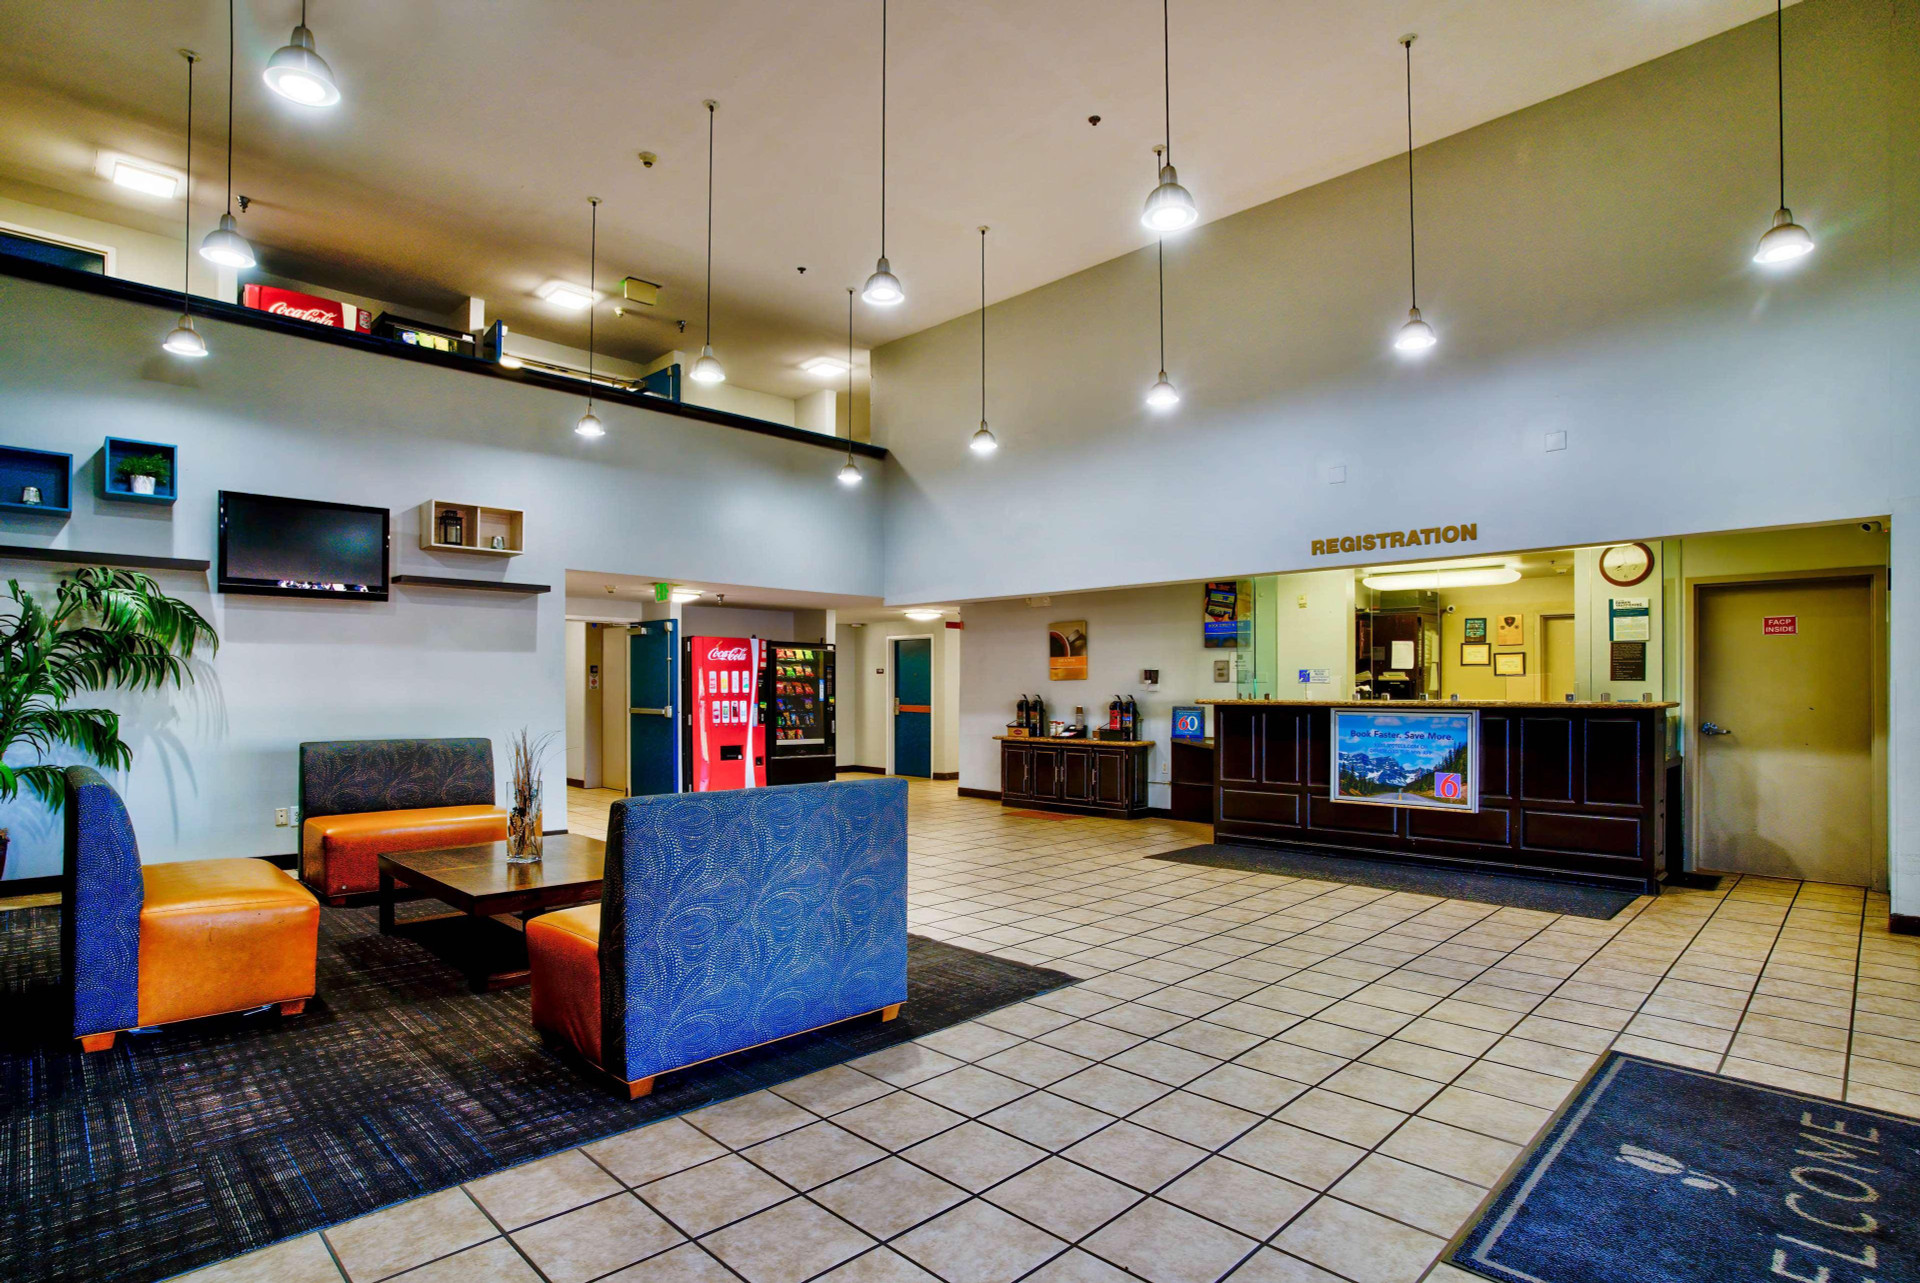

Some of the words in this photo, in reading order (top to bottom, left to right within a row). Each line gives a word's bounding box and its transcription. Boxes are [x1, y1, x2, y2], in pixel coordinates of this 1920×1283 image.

[268, 302, 337, 326] Coca-Cola
[1311, 523, 1477, 556] REGISTRATION
[707, 647, 748, 661] Coca-Cola
[1178, 716, 1198, 731] 60
[1350, 730, 1371, 738] Book
[1374, 730, 1402, 739] Faster.
[1404, 731, 1425, 740] Save
[1427, 732, 1454, 741] More.
[1440, 773, 1459, 798] 6
